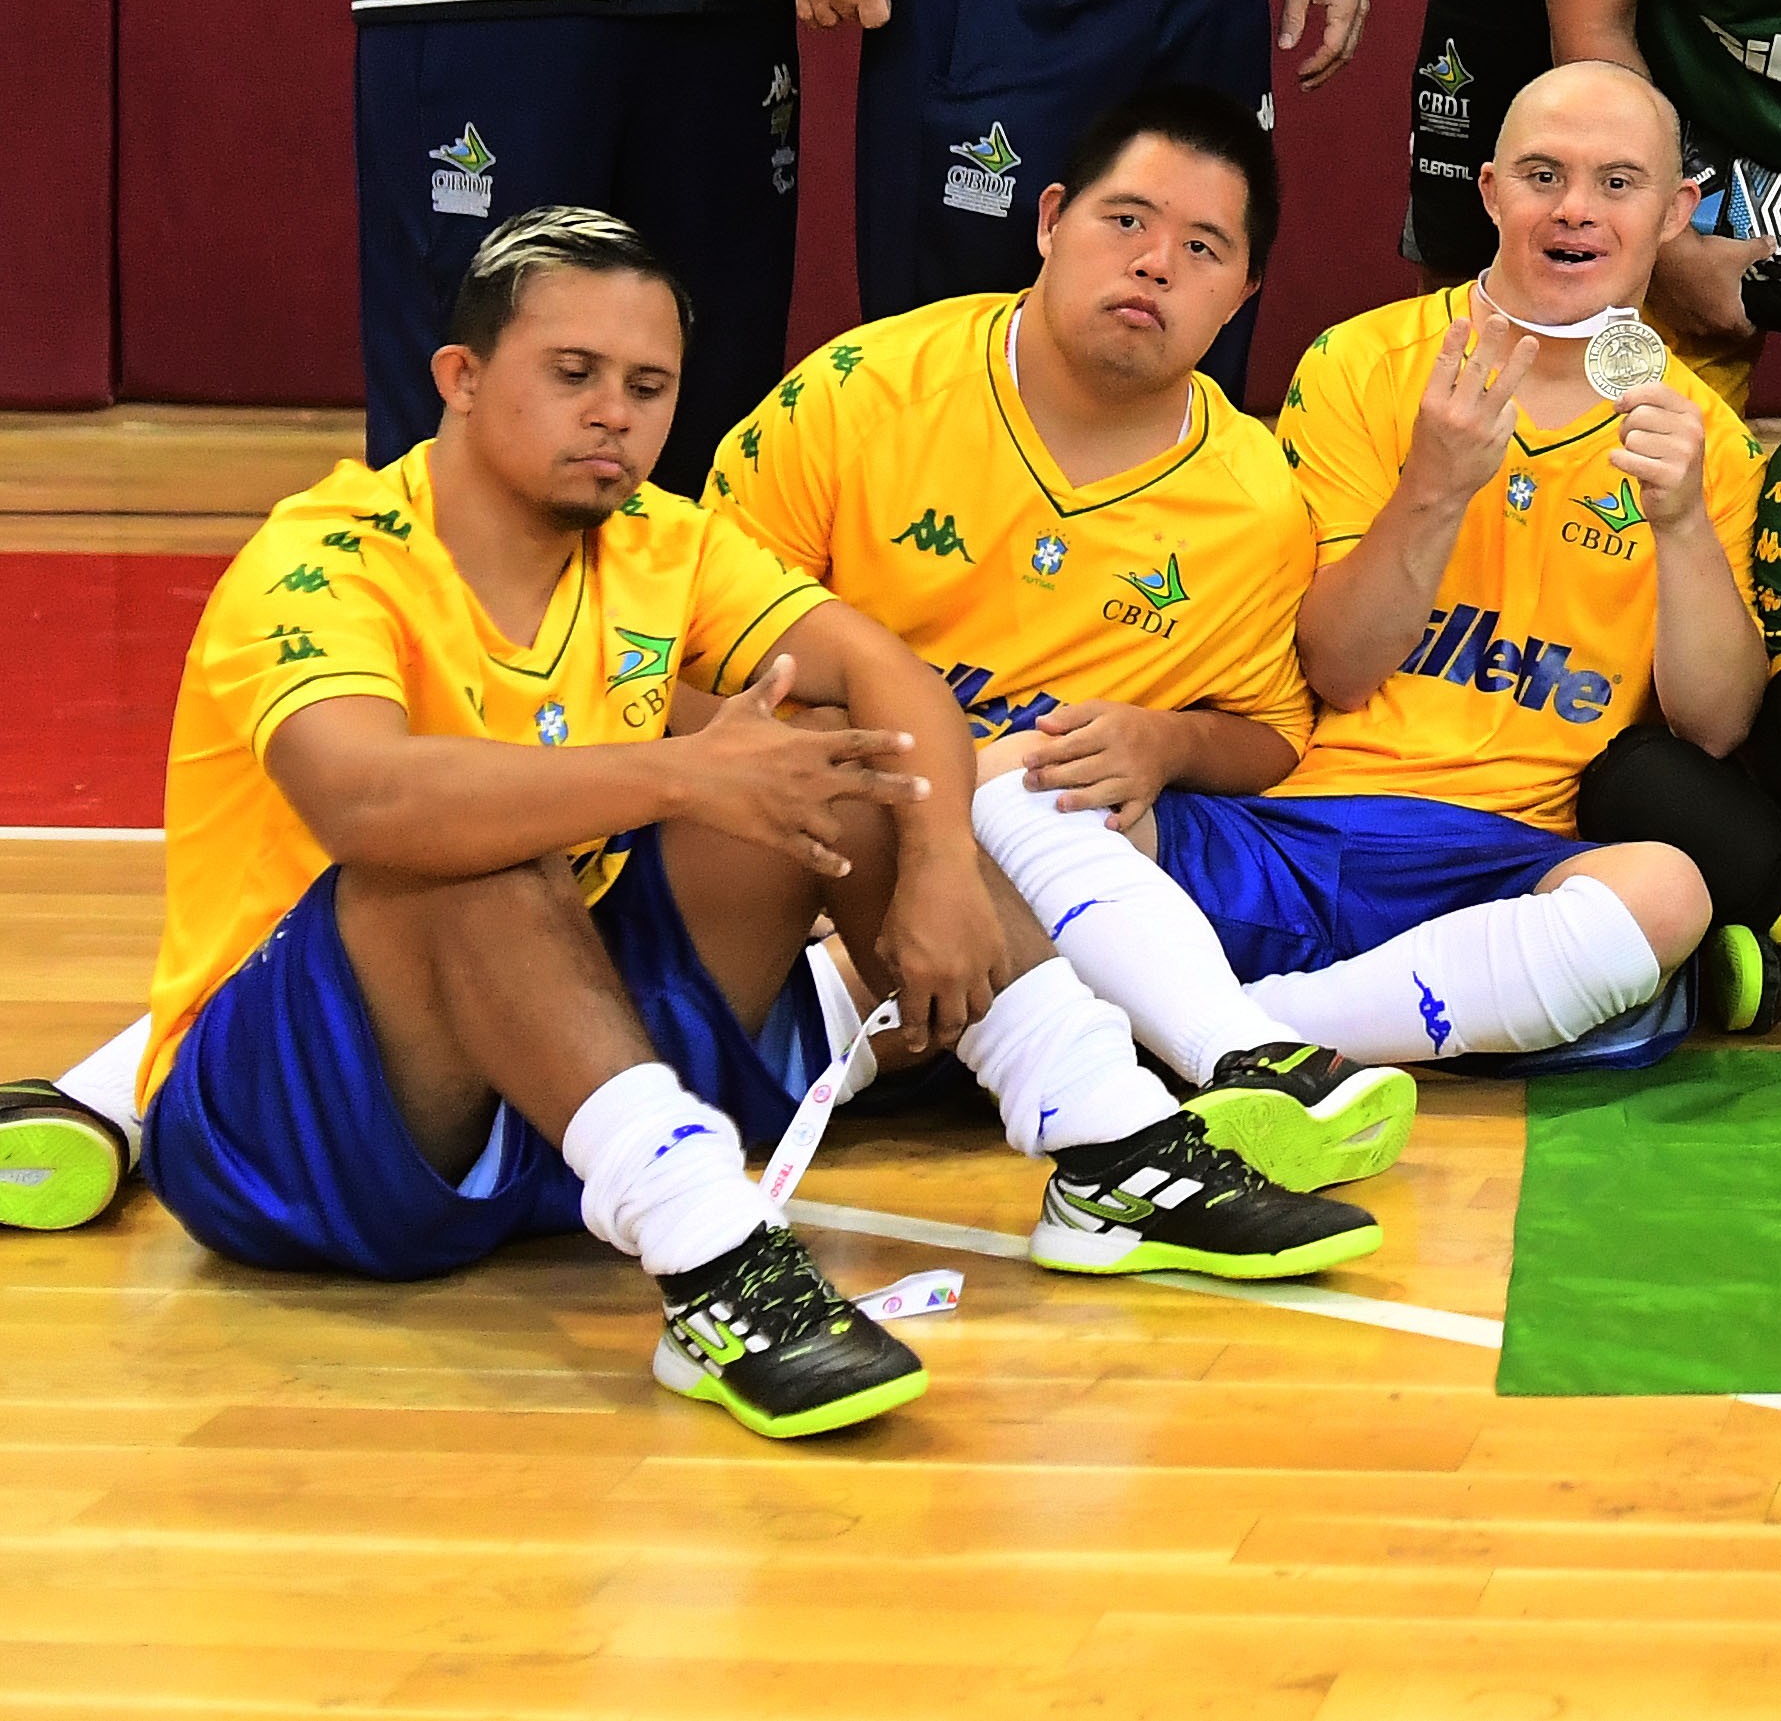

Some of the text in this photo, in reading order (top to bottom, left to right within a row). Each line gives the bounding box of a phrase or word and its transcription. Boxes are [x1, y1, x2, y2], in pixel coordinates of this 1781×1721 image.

[1418, 90, 1471, 118] CBDI
[1561, 521, 1638, 561] CBDI
[1102, 599, 1179, 640] CBDI
[1398, 603, 1612, 724] illette
